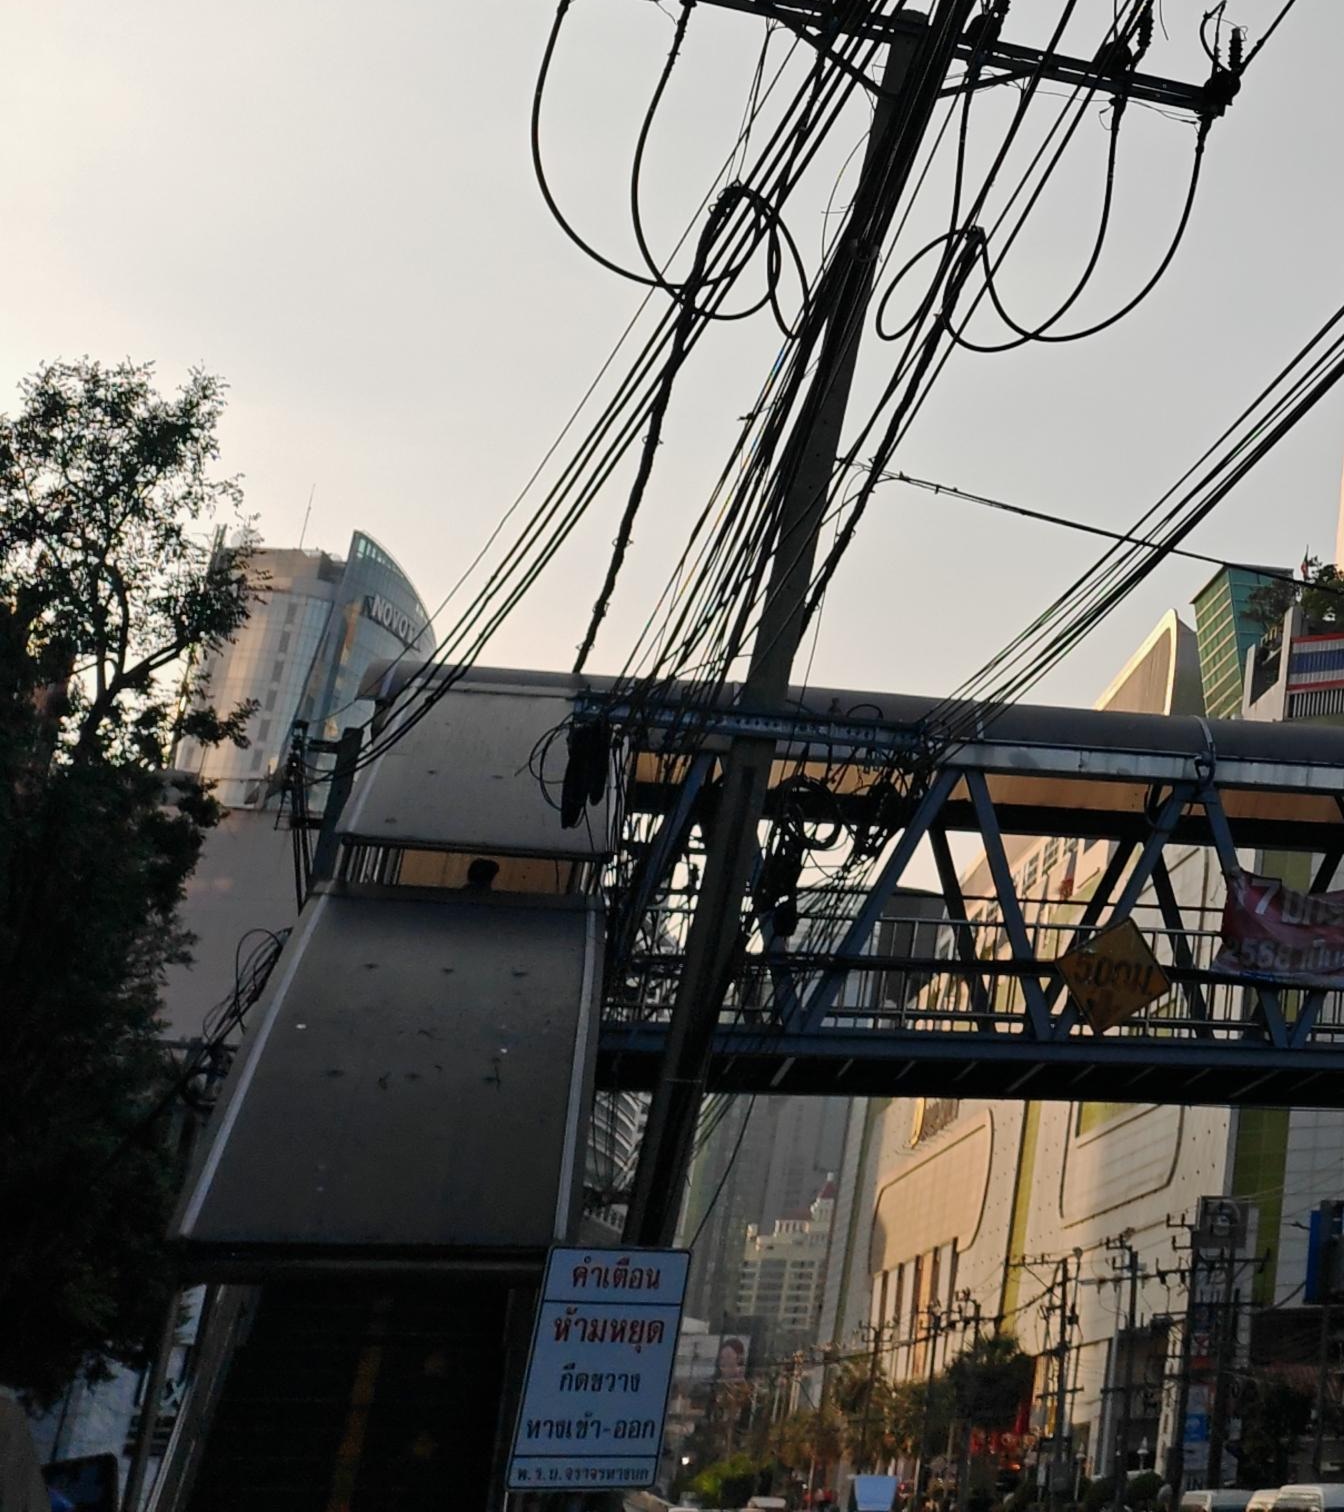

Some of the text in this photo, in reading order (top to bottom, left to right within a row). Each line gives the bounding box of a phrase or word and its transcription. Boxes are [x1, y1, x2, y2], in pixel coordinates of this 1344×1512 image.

[572, 1255, 661, 1290] คำเตือน
[553, 1306, 665, 1354] ห้ามหยุด
[559, 1362, 641, 1393] กีดขวาง
[527, 1411, 656, 1441] ทางเข้า-ออก
